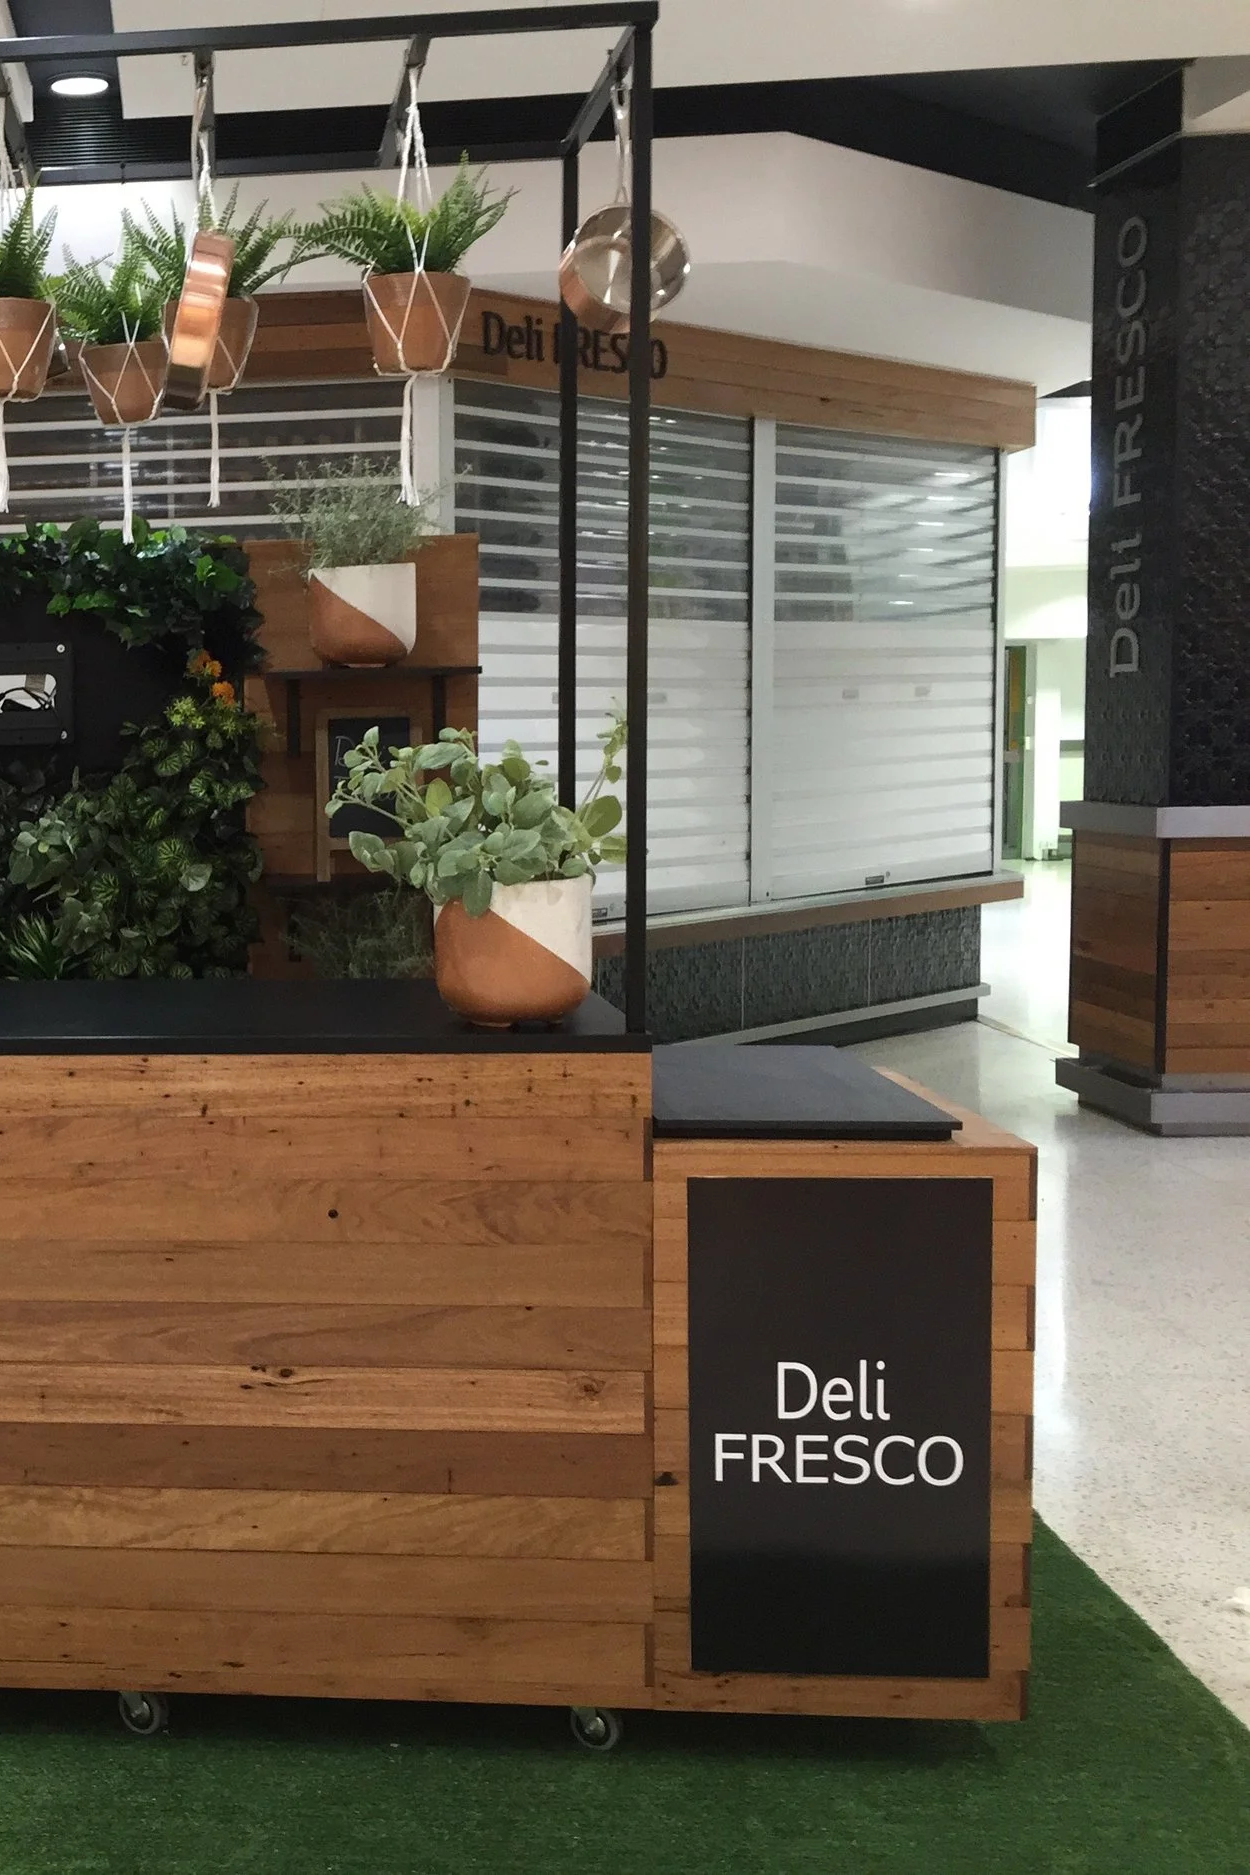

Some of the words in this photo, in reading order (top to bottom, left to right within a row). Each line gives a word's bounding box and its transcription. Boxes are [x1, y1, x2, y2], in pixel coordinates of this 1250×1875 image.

[481, 310, 545, 363] Deli
[553, 320, 668, 380] RESO
[1111, 214, 1149, 509] FRESCO
[1108, 531, 1143, 679] Deli
[777, 1359, 891, 1421] Deli
[714, 1433, 964, 1487] FRESCO
